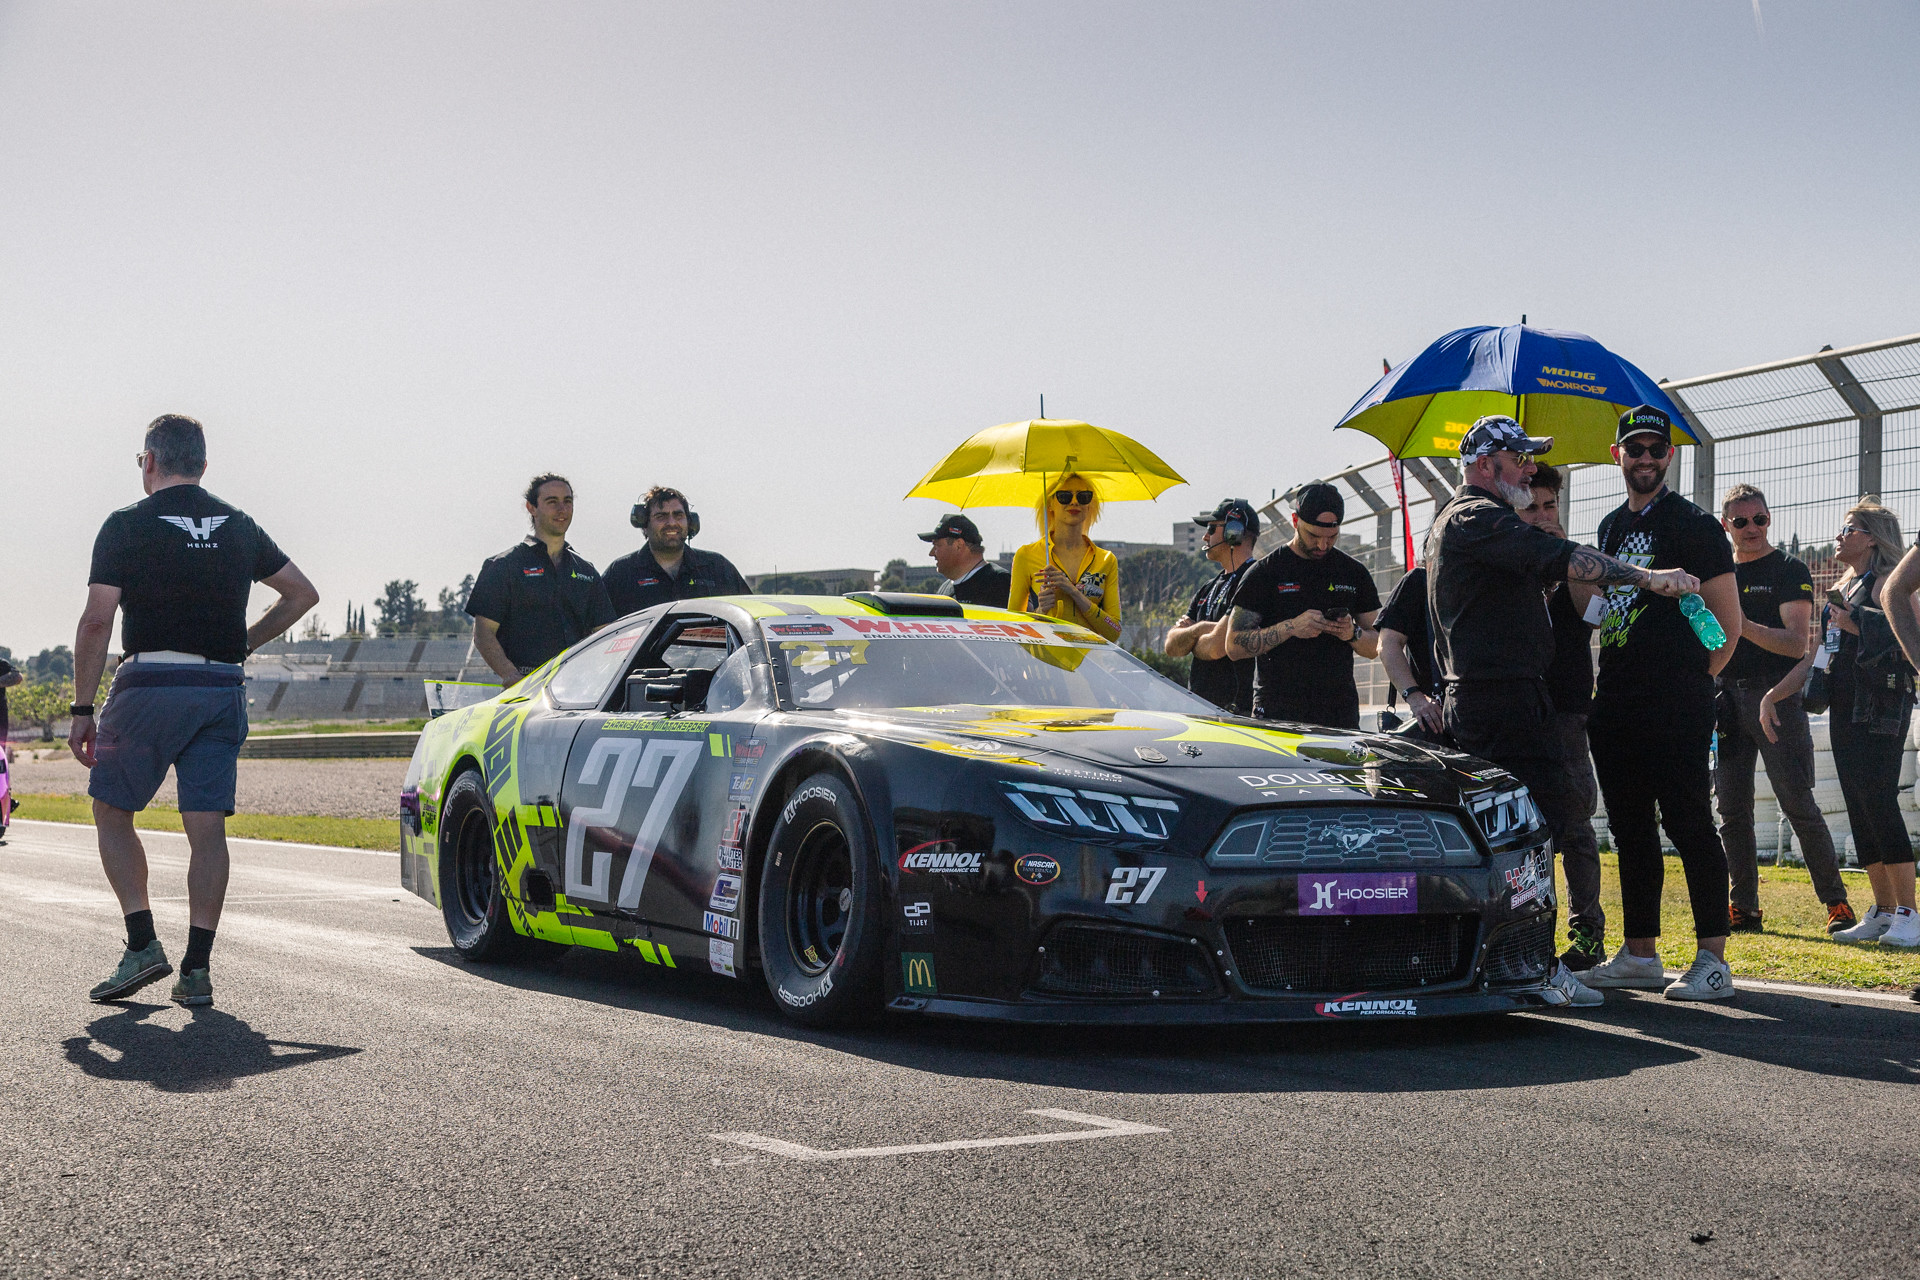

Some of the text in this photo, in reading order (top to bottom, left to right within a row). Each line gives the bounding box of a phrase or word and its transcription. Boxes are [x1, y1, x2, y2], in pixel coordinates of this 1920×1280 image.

[1542, 366, 1596, 381] MOOG
[1545, 380, 1600, 395] MONROE
[836, 617, 1045, 639] WHELEN
[960, 635, 1022, 644] COMPANY
[779, 640, 871, 666] 27
[602, 718, 636, 730] SHARKS
[653, 720, 711, 732] MOTORSPORT
[1053, 768, 1122, 779] TESTING
[1238, 774, 1383, 788] DOUBLE
[794, 786, 836, 809] HOOSIER
[1261, 788, 1429, 799] RACING
[565, 737, 704, 908] 27
[721, 856, 744, 869] MASTER
[903, 852, 981, 868] KENNOL
[1027, 860, 1056, 869] NASCAR
[1105, 867, 1167, 904] 27
[1338, 887, 1409, 900] HOOSIER
[1510, 885, 1538, 909] SHARKS
[705, 913, 738, 938] Mobil 1
[778, 984, 822, 1007] HOOSIER
[1323, 999, 1417, 1013] KENNOL
